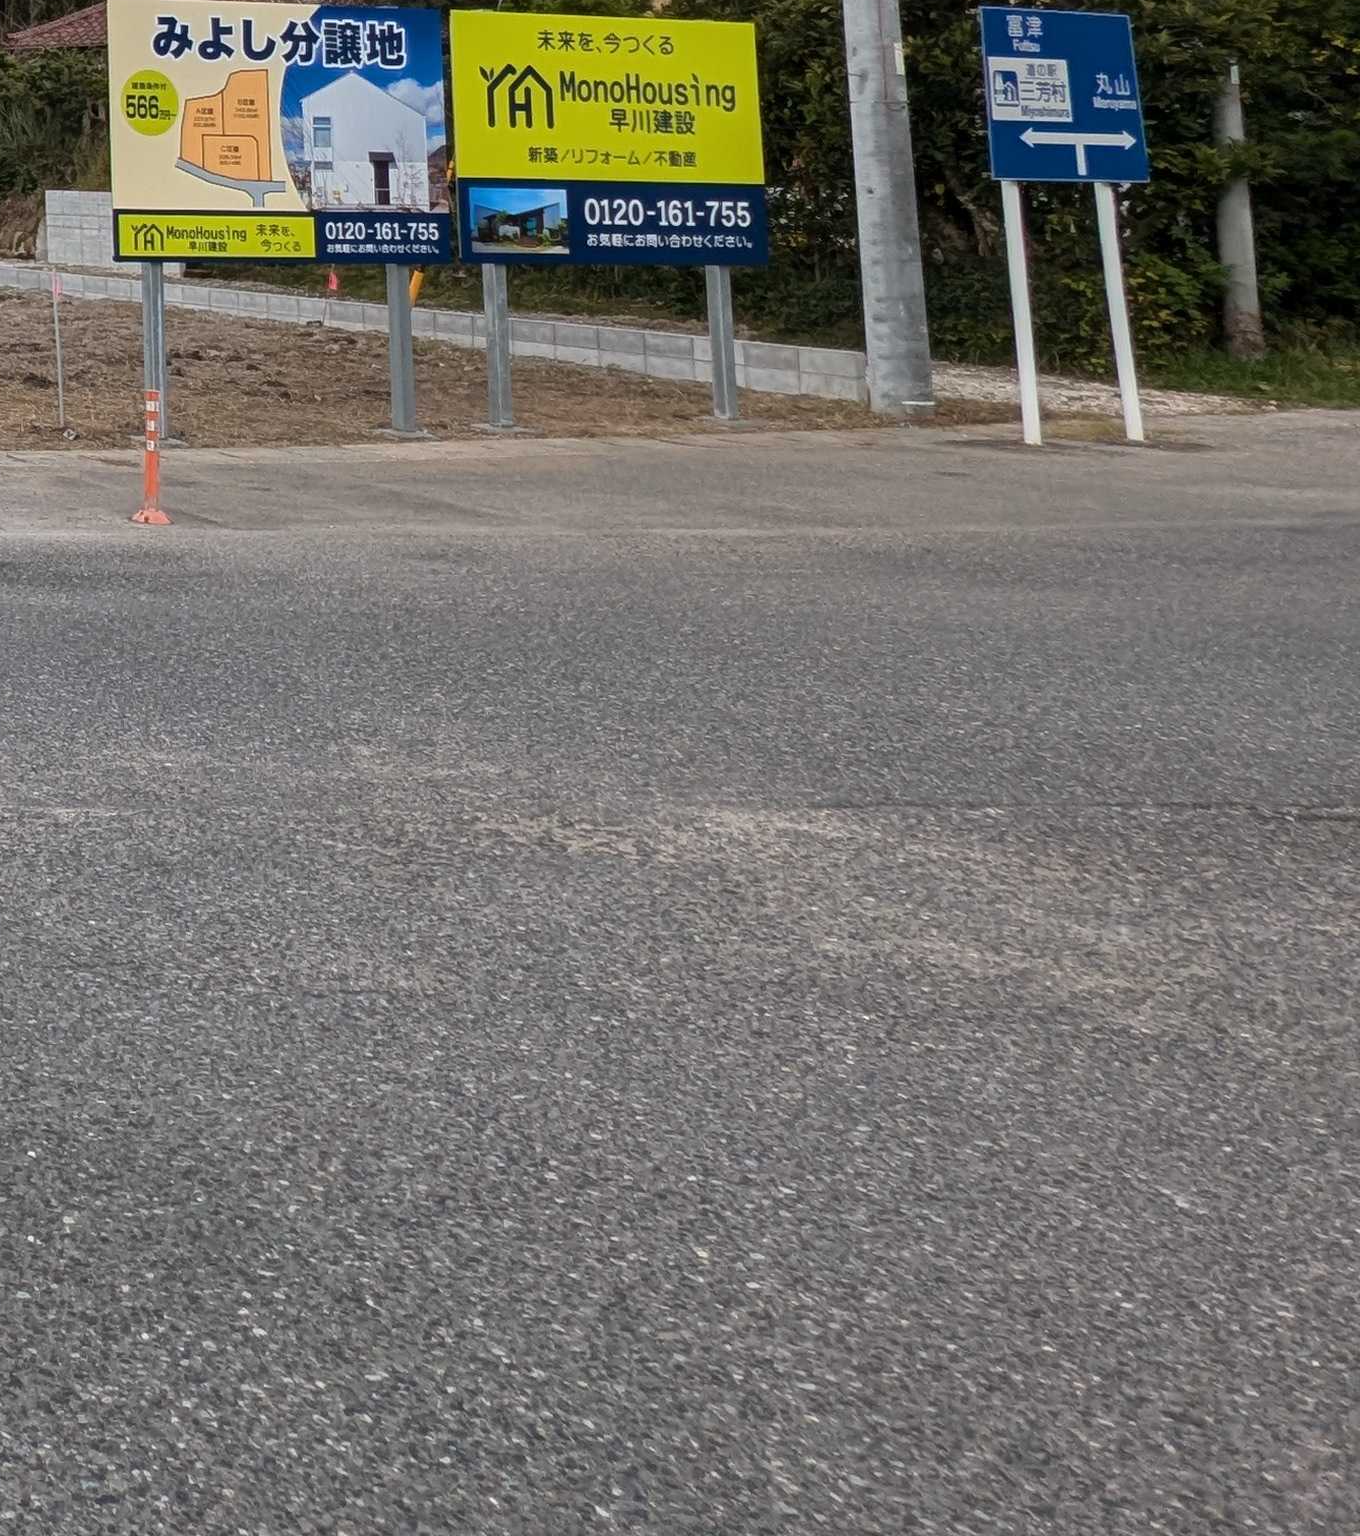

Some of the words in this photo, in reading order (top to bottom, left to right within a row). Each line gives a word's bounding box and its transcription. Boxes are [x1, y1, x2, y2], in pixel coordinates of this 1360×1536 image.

[152, 15, 406, 67] みよし分譲地
[537, 29, 674, 56] 未来を、今つくる
[559, 70, 736, 112] MonoHousing
[1020, 80, 1066, 103] 三芳村
[1096, 72, 1131, 95] 丸山
[609, 108, 695, 135] 早川建設
[584, 198, 752, 227] 0120-161-755
[166, 225, 247, 241] MonoHousing
[325, 222, 439, 240] 0120-161-755
[586, 233, 753, 249] お気軽にお問い合わせください。
[260, 239, 302, 252] 今つくる
